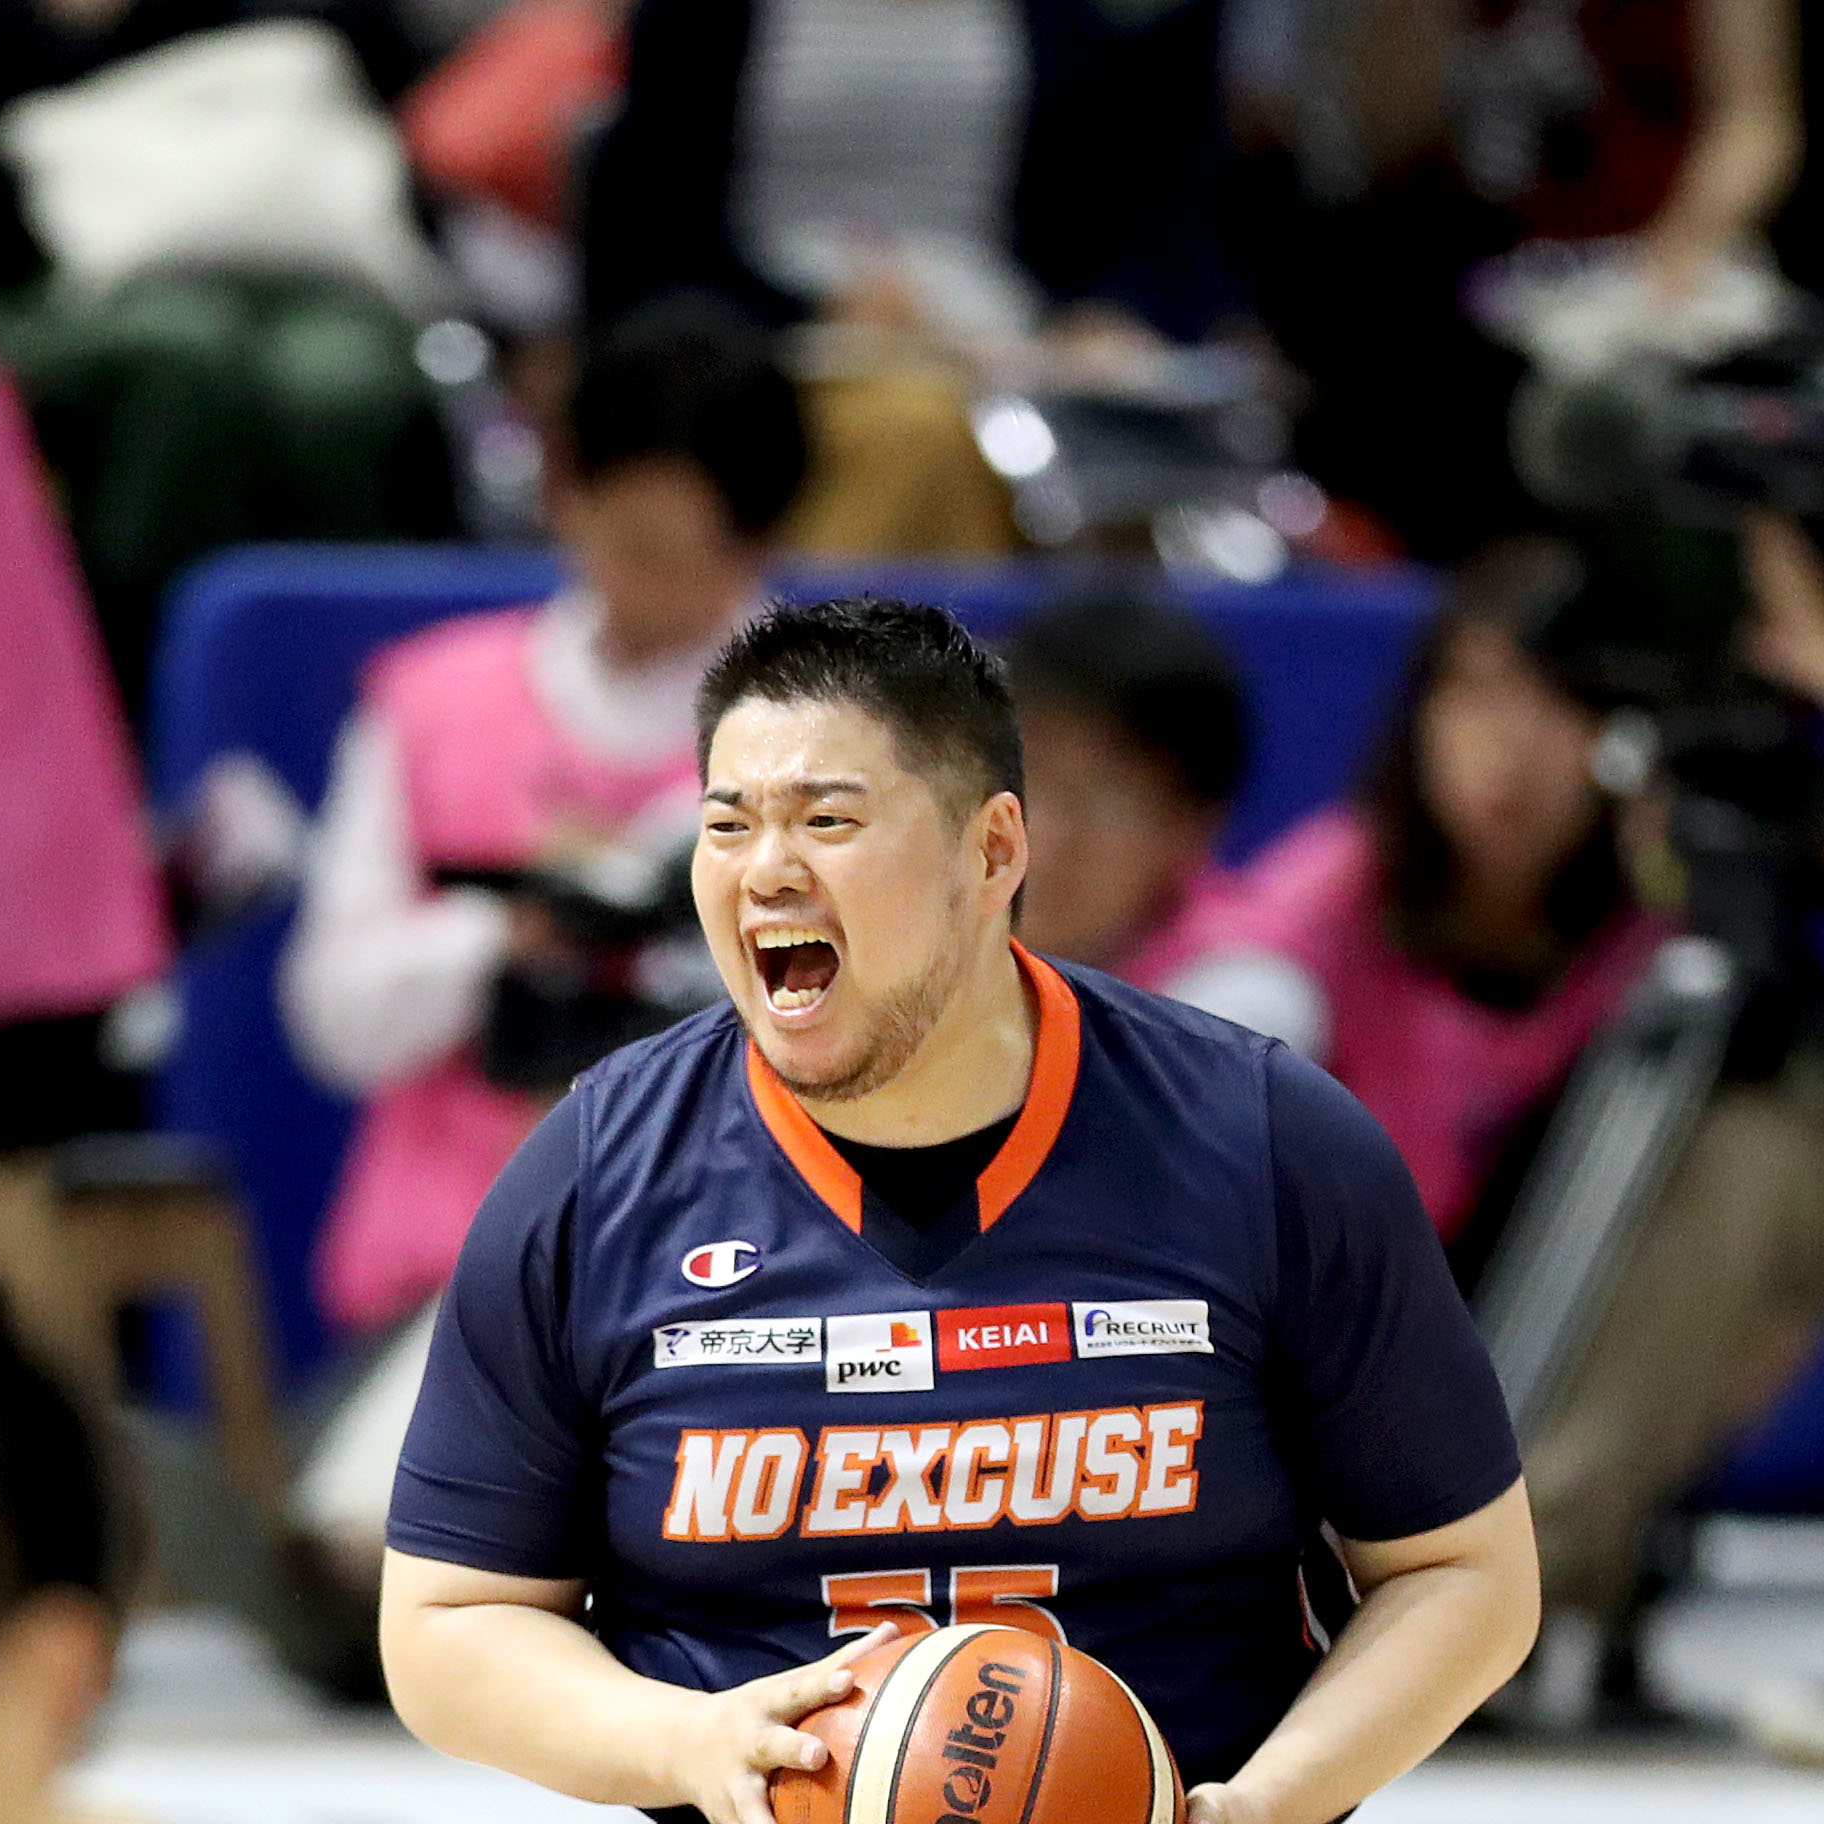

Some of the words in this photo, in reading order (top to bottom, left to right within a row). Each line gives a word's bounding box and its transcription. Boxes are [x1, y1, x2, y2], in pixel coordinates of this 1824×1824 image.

[700, 1327, 816, 1355] 帝京大学
[957, 1321, 1049, 1351] KEIAI
[837, 1358, 902, 1384] pwc
[662, 1427, 809, 1543] NO
[800, 1401, 1204, 1539] EXCUSE
